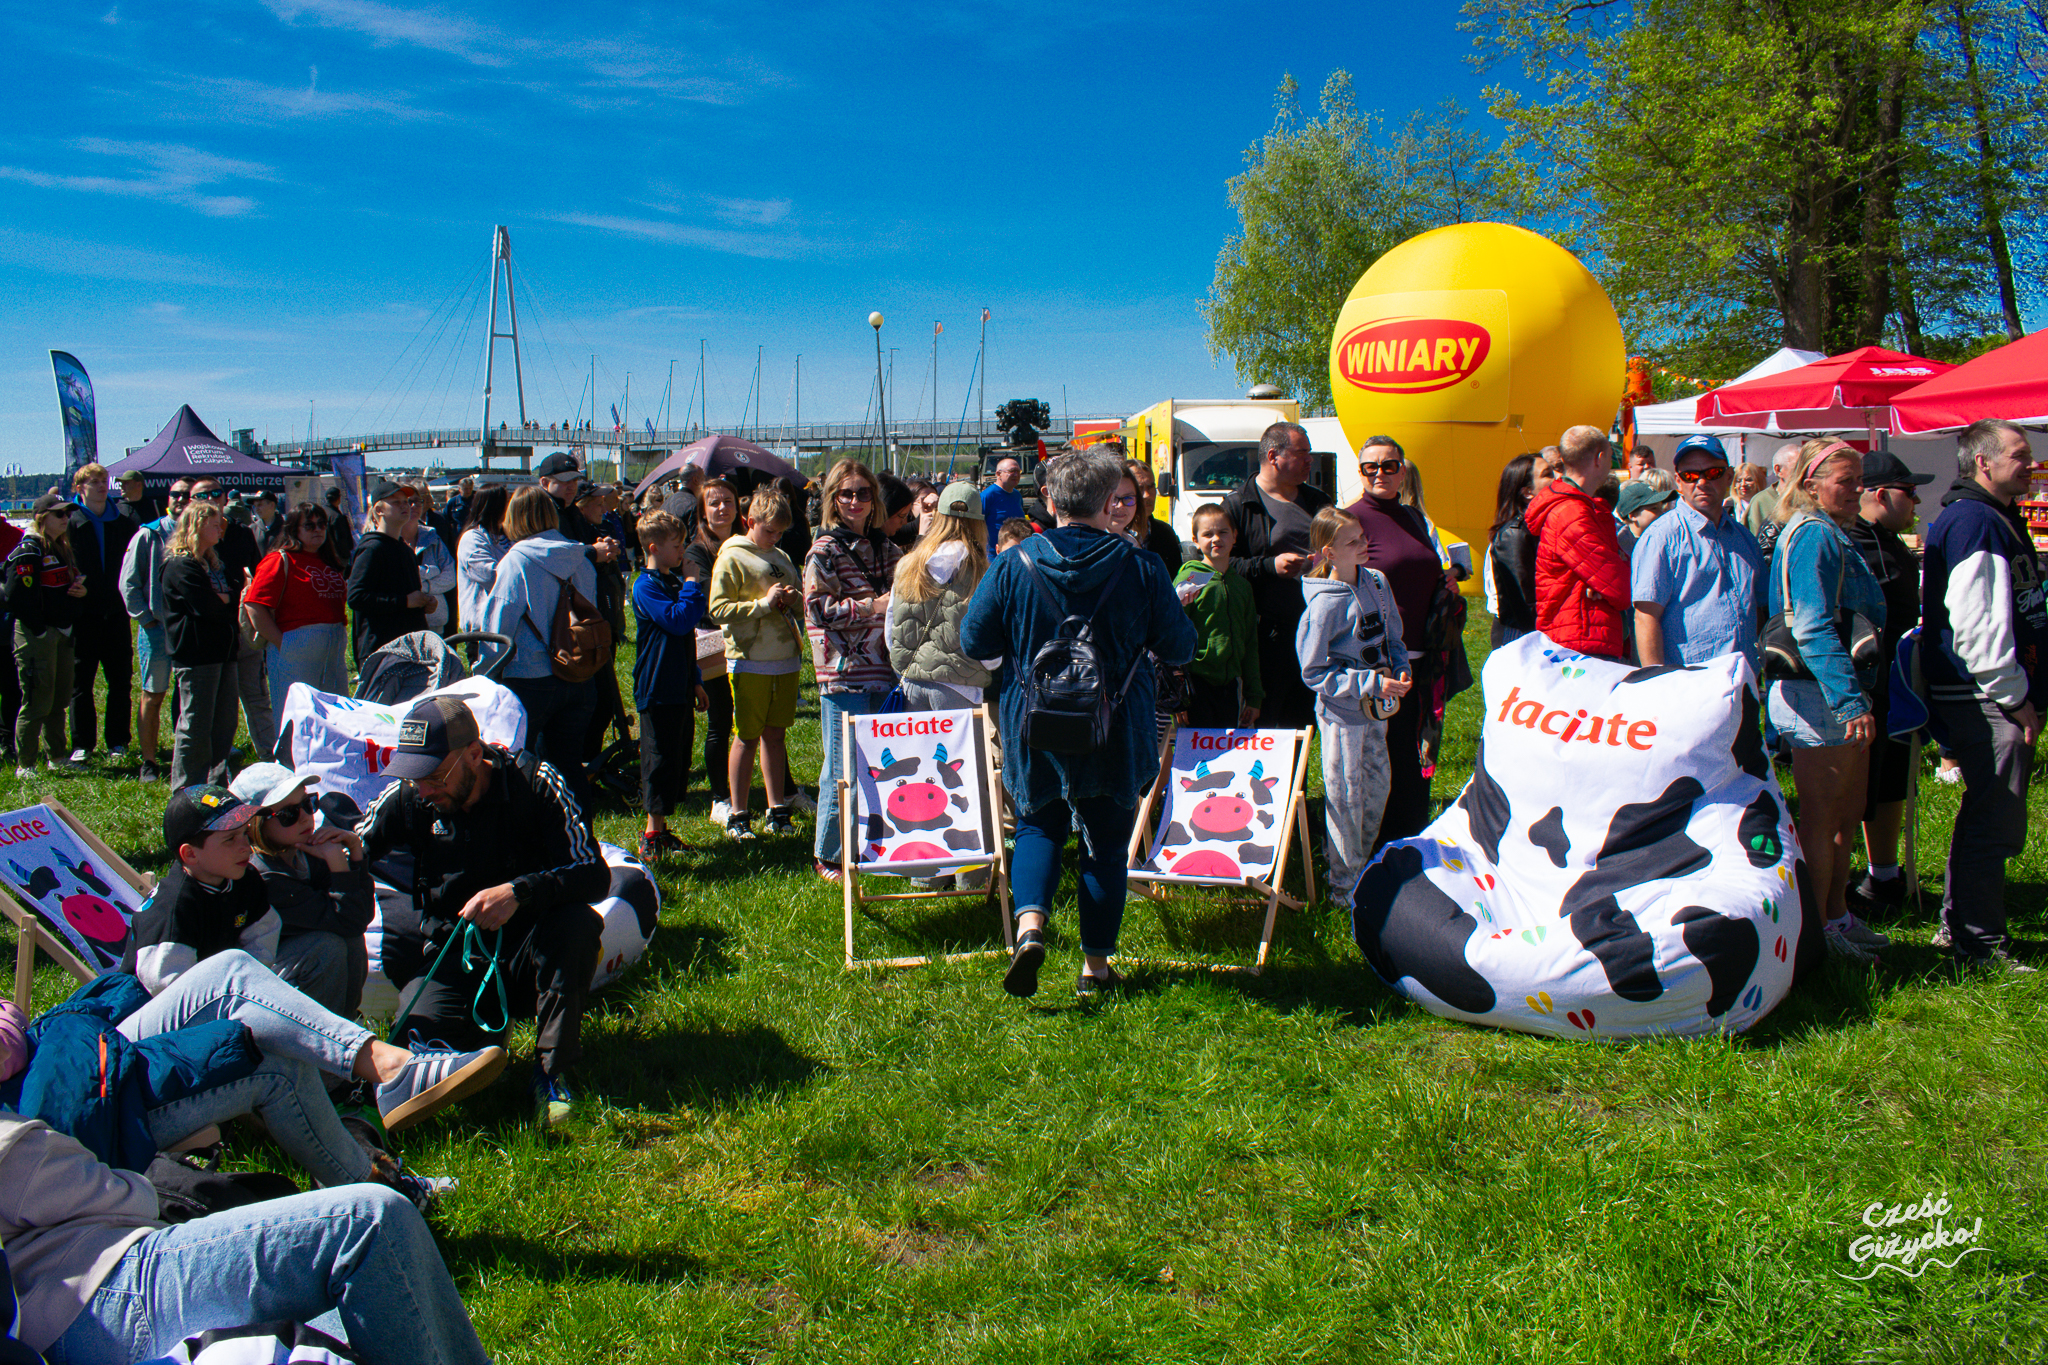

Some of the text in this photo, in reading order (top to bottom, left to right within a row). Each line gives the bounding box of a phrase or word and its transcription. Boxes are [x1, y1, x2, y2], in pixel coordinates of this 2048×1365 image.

[1347, 337, 1481, 376] WINIARY
[187, 443, 228, 452] Wojskowe
[189, 448, 224, 456] Centrum
[871, 717, 953, 737] łaciate
[1497, 686, 1657, 751] łaciate
[1191, 731, 1275, 751] łaciate
